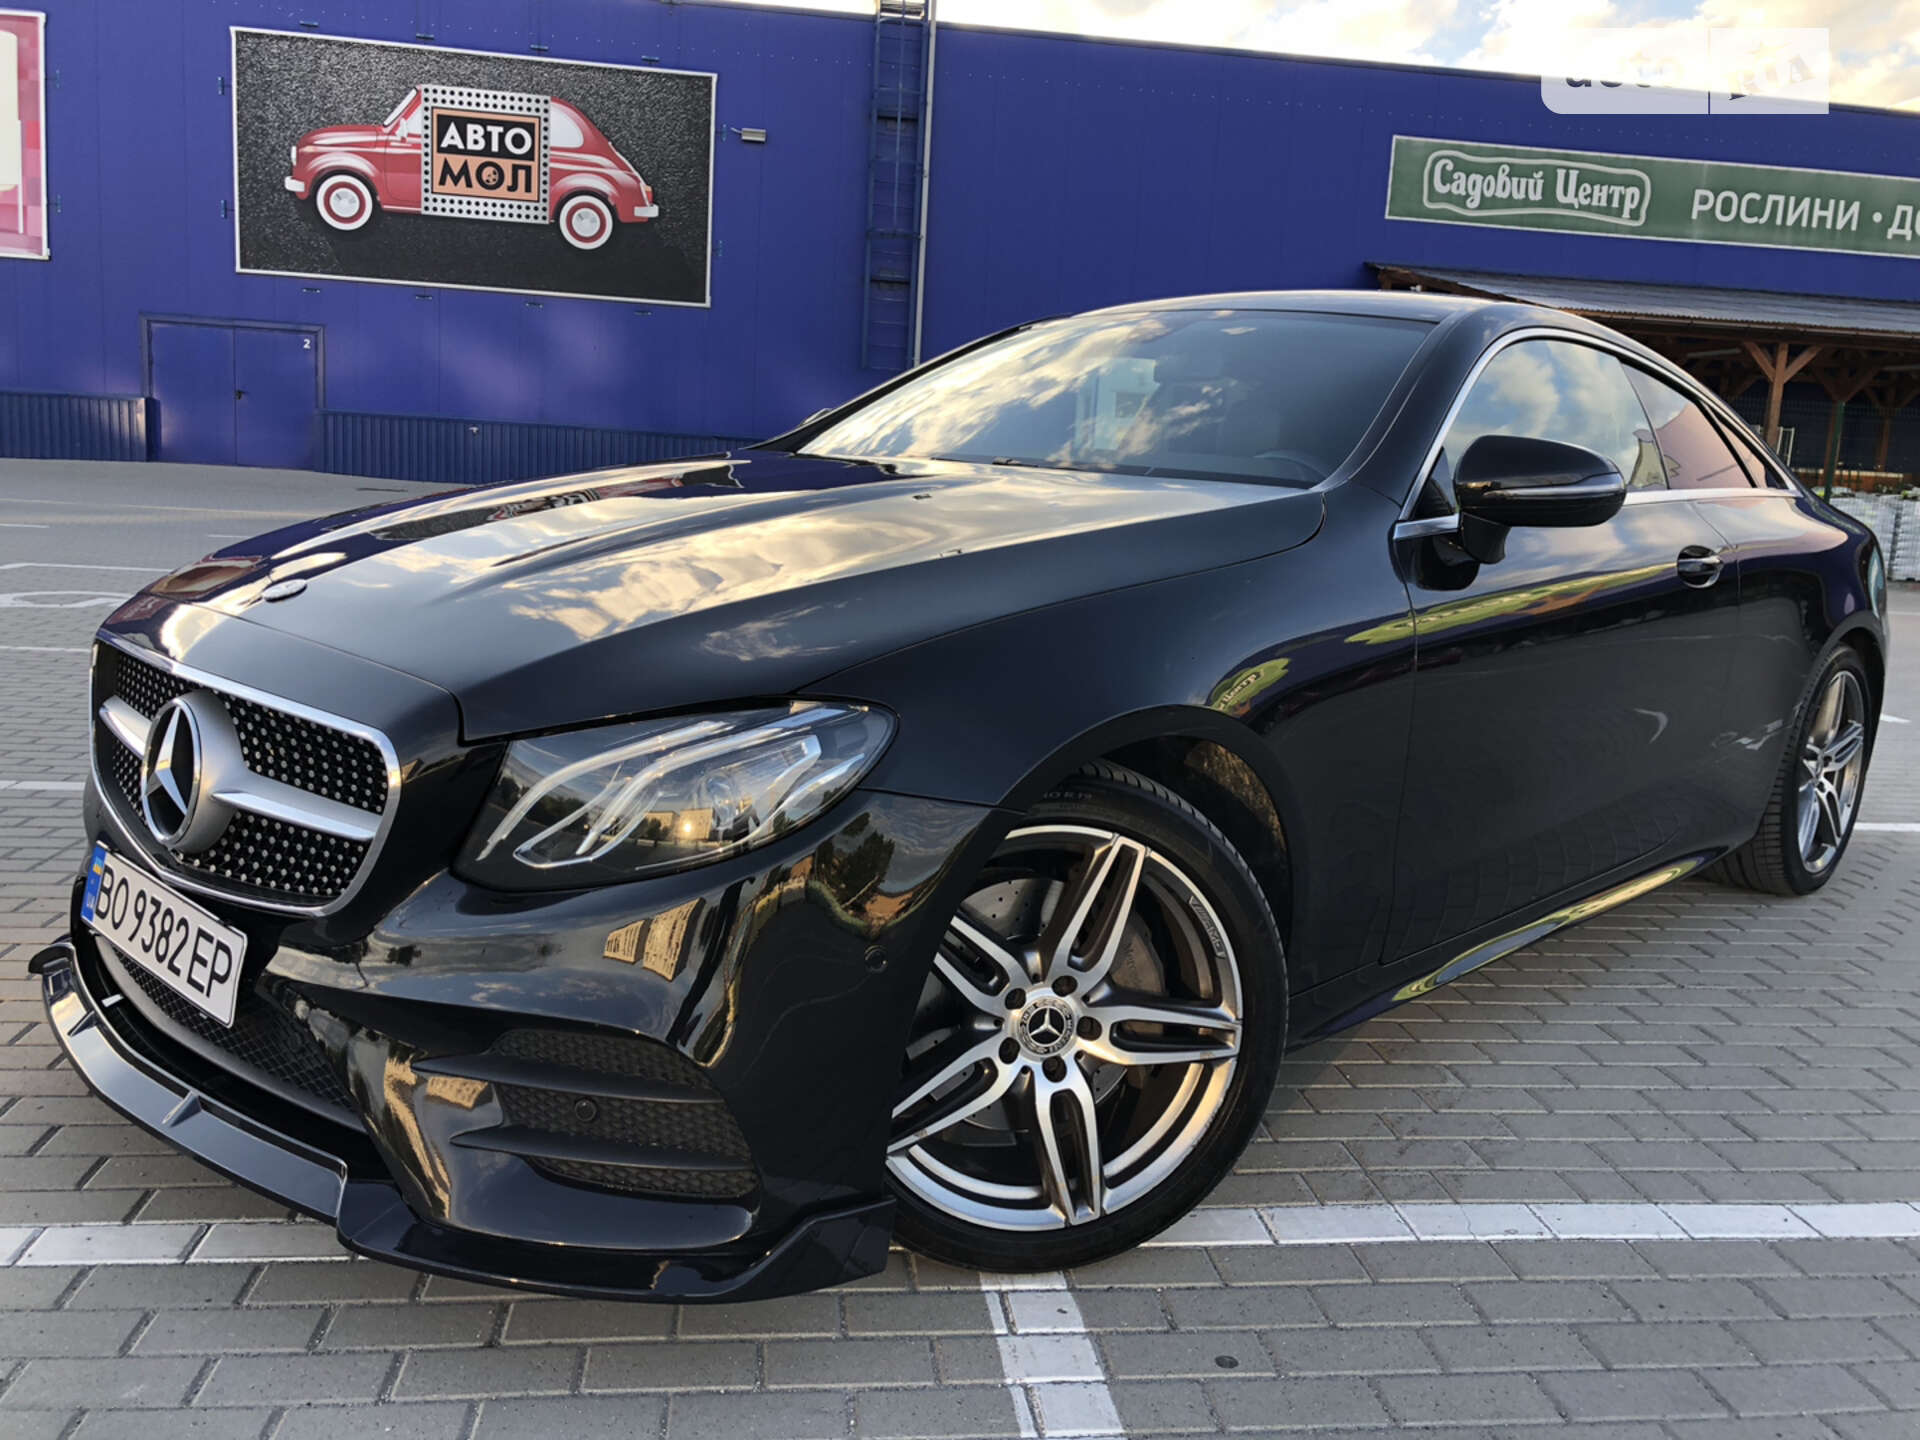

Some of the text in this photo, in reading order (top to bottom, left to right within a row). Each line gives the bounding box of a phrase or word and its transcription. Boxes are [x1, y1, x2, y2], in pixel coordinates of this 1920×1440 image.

[440, 121, 532, 155] АВТО
[438, 157, 532, 193] МОЛ
[1433, 158, 1641, 218] Садовий Центр
[1691, 188, 1920, 240] РОСЛИНИ Д
[303, 338, 311, 349] 2
